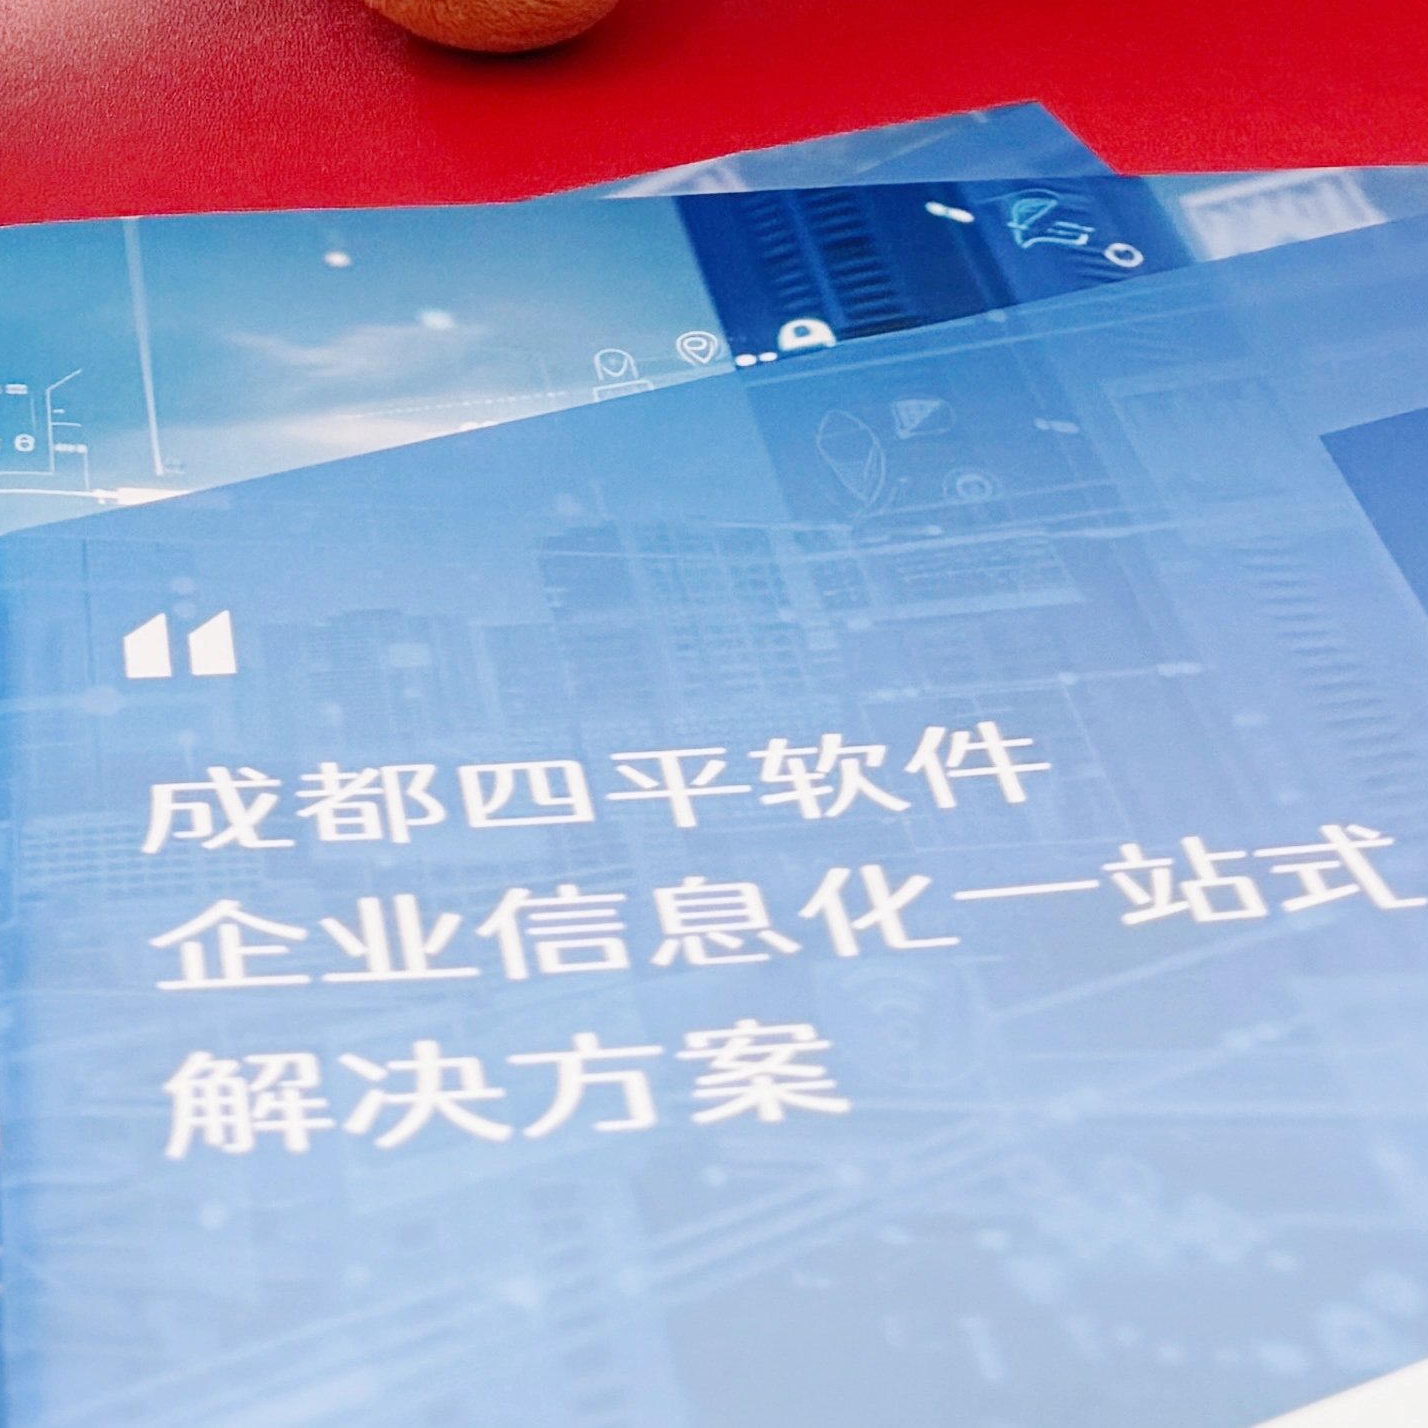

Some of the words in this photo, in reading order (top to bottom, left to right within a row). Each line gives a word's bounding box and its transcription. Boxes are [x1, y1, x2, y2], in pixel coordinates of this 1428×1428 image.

[140, 719, 1052, 854] 成都四平软件
[162, 1017, 853, 1160] 解决方案
